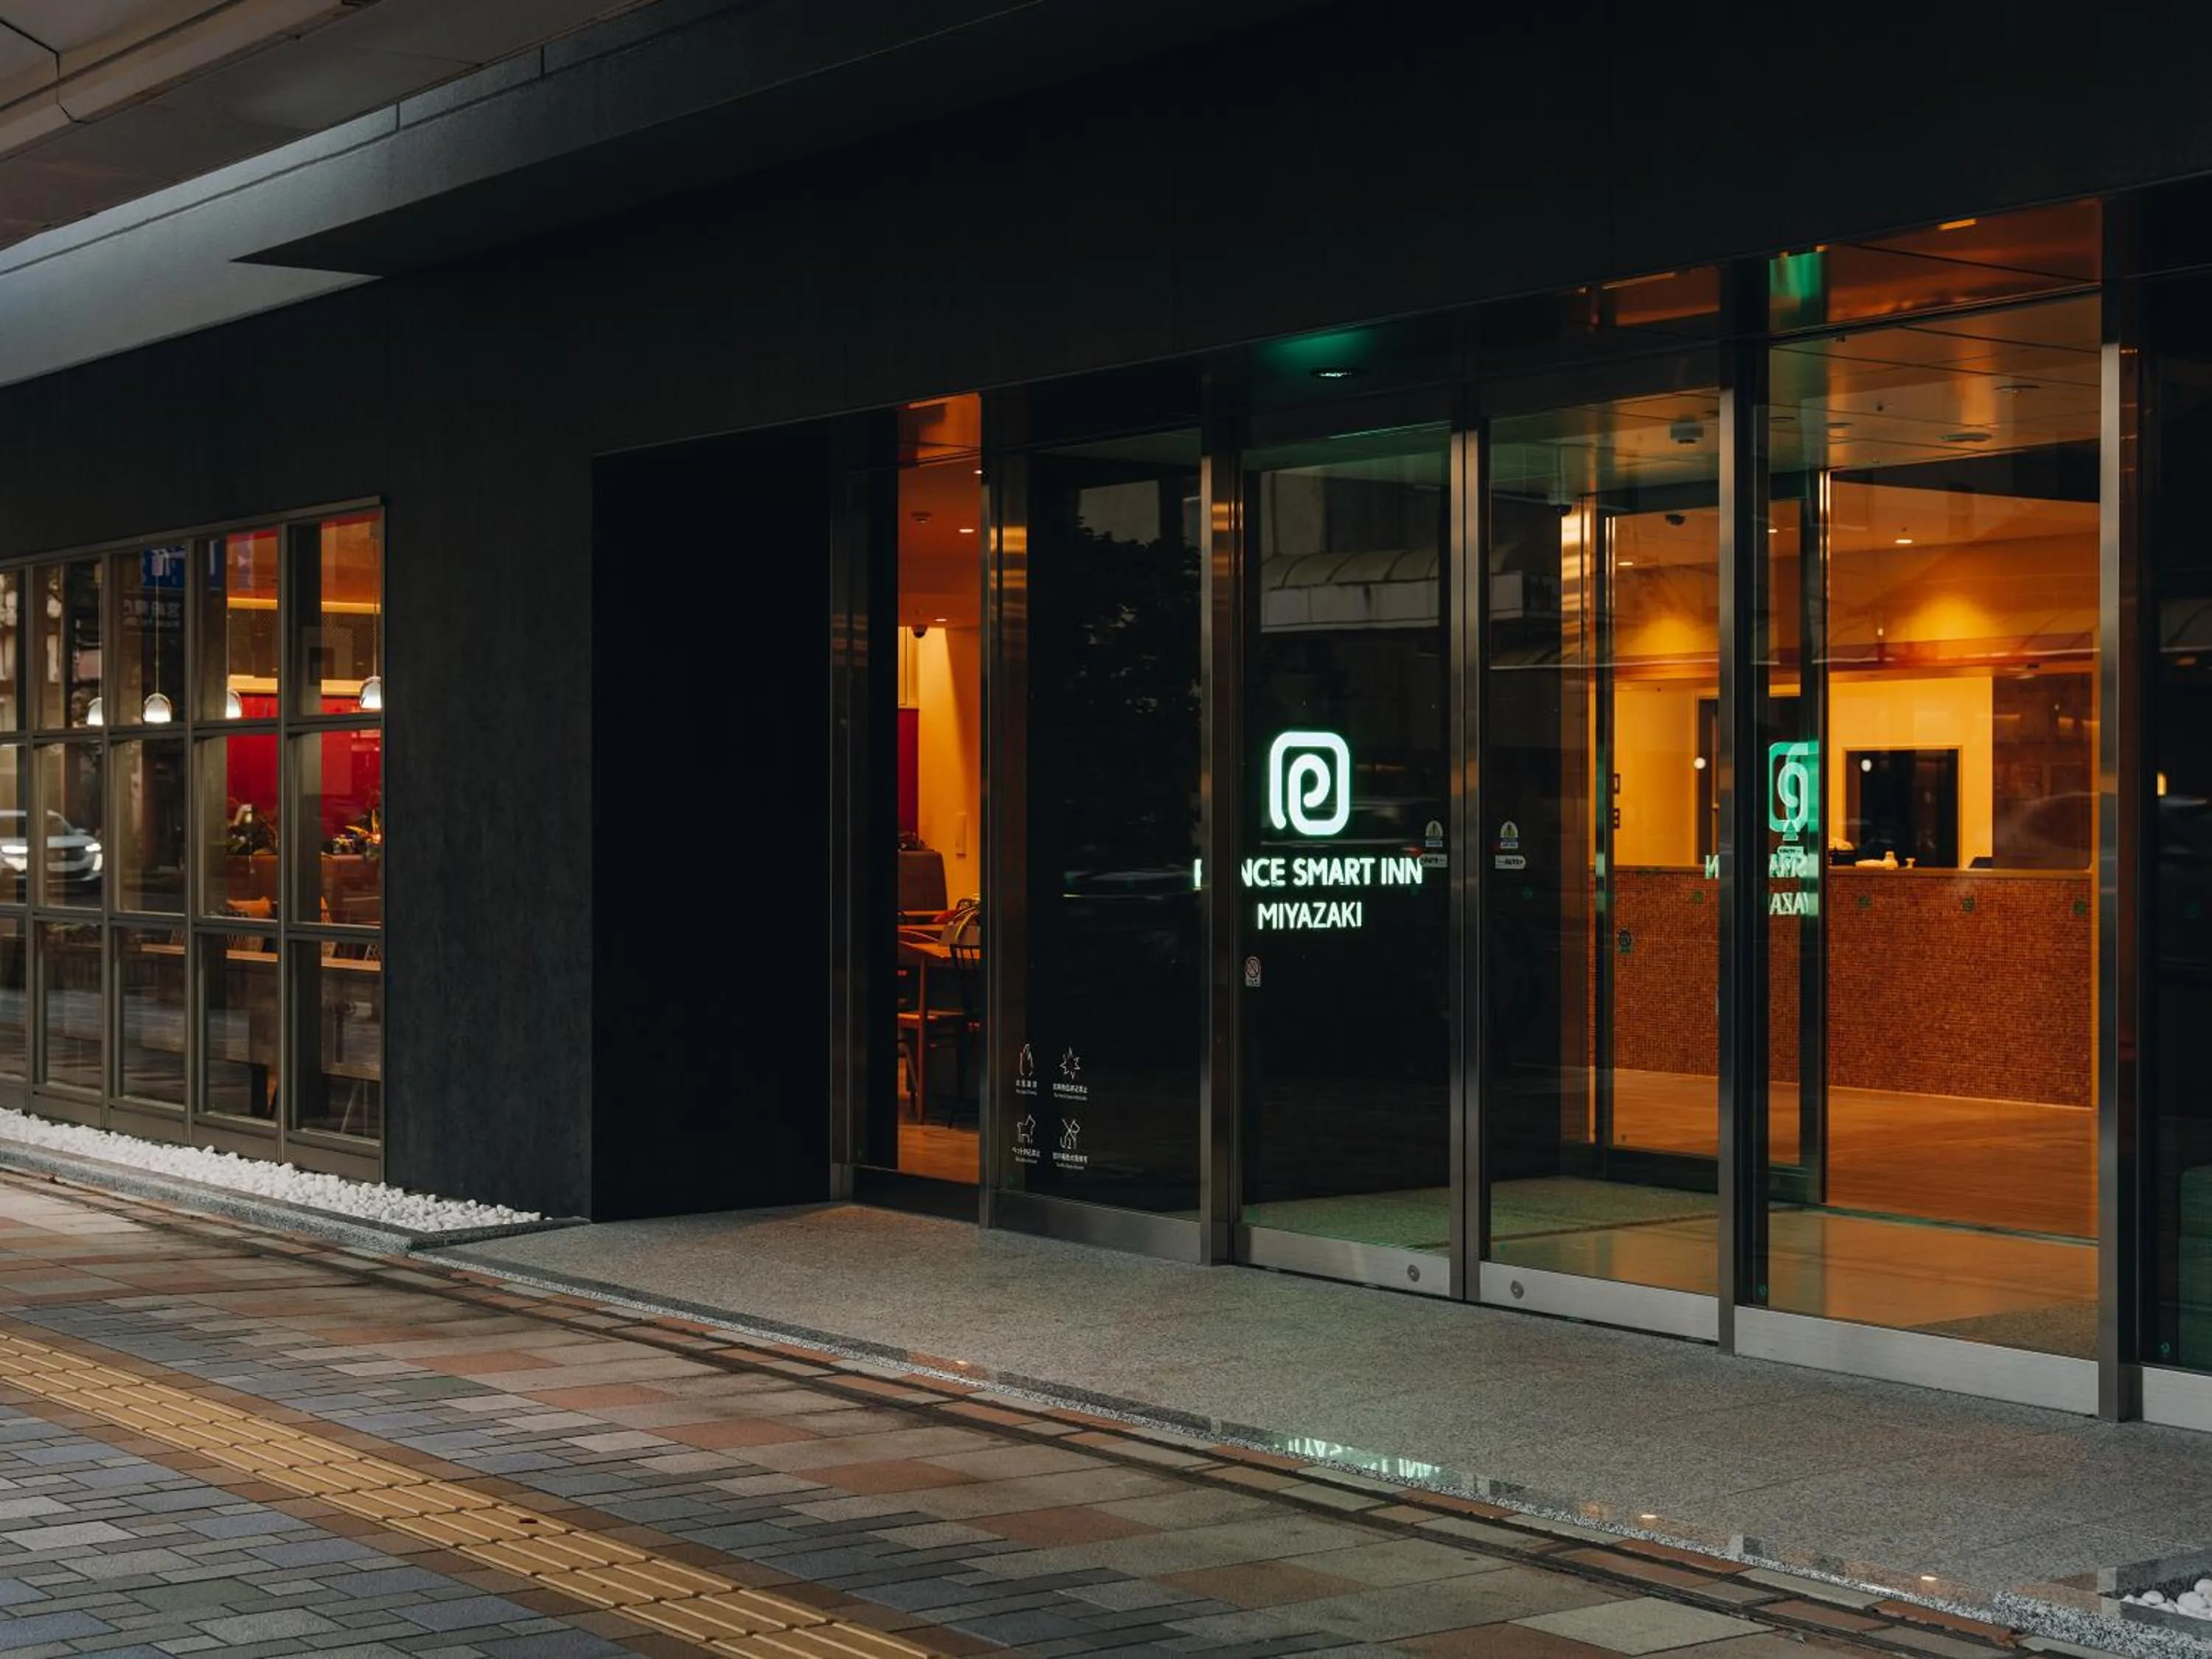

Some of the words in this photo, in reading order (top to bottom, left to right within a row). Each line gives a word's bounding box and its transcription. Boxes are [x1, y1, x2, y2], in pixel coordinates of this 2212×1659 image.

[1194, 858, 1286, 889] NCE
[1292, 858, 1375, 886] SMART
[1380, 858, 1422, 885] INN
[1257, 902, 1363, 930] MIYAZAKI
